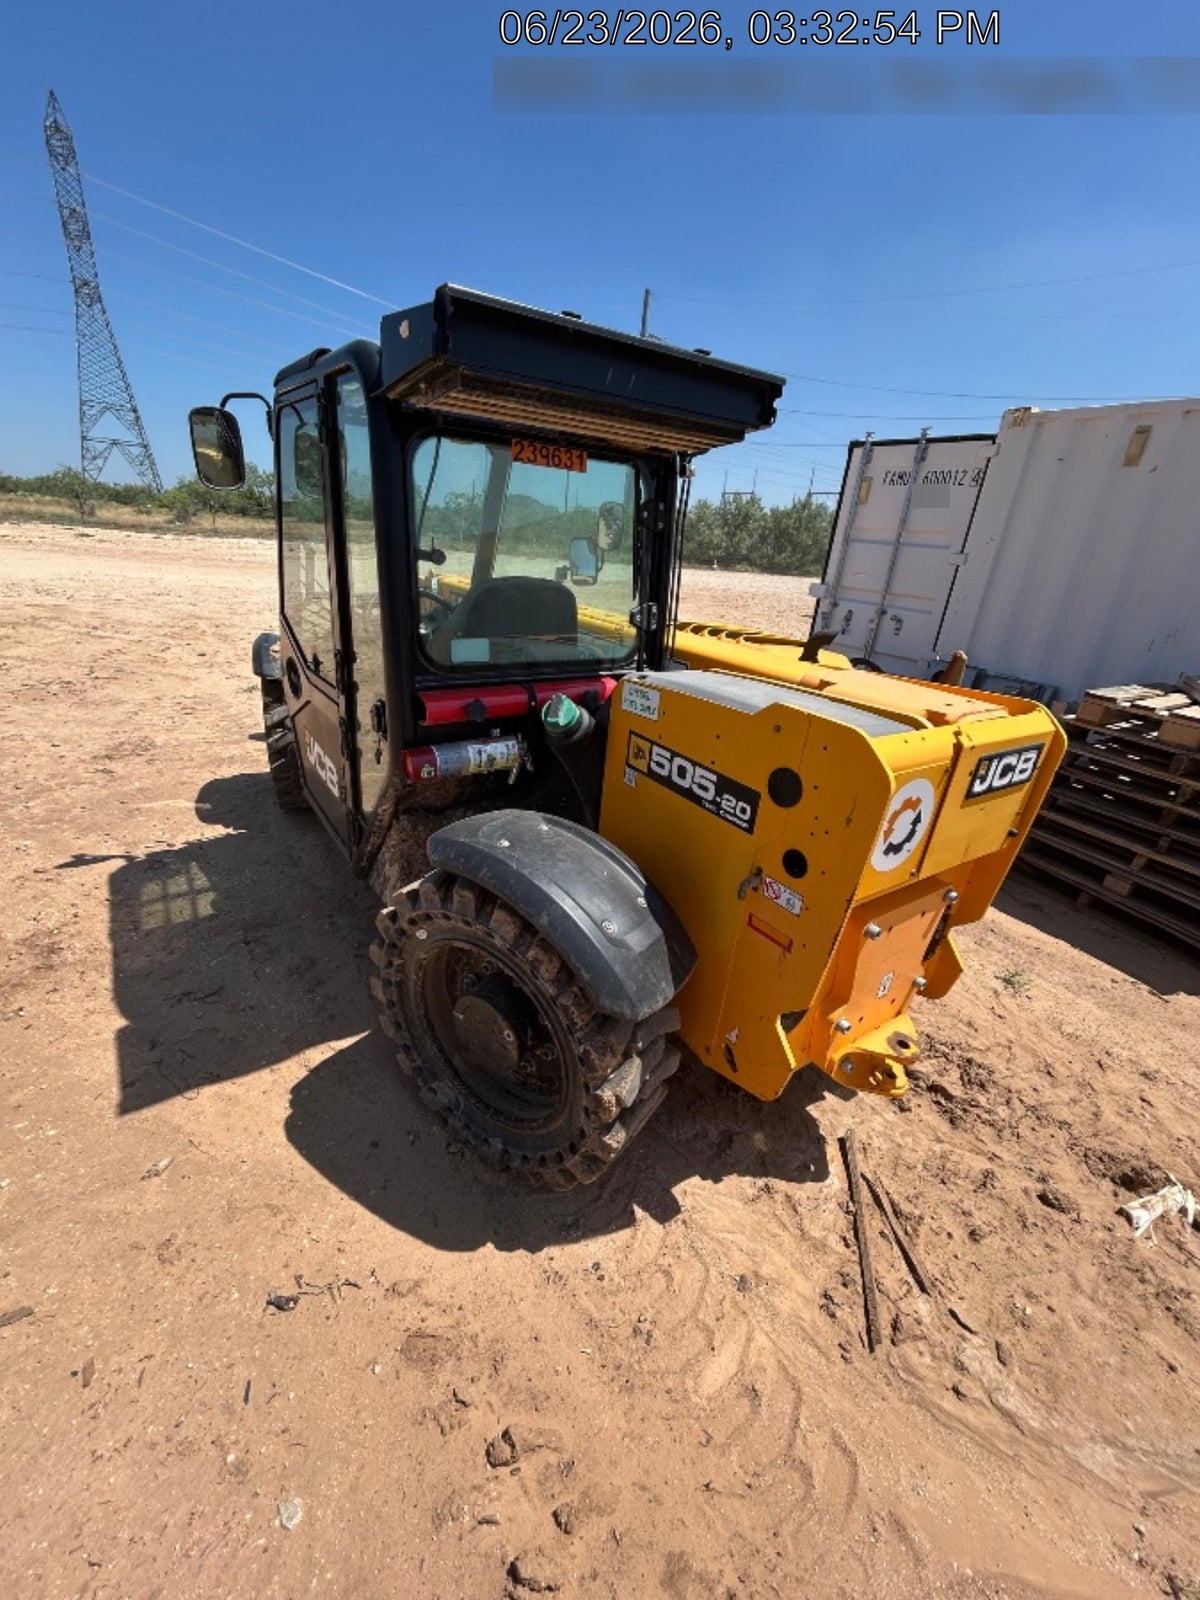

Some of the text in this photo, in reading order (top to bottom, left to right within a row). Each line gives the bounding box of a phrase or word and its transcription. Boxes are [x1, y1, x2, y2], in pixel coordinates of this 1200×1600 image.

[513, 440, 584, 467] 239631
[307, 736, 339, 797] JCB
[972, 749, 1038, 793] JCB
